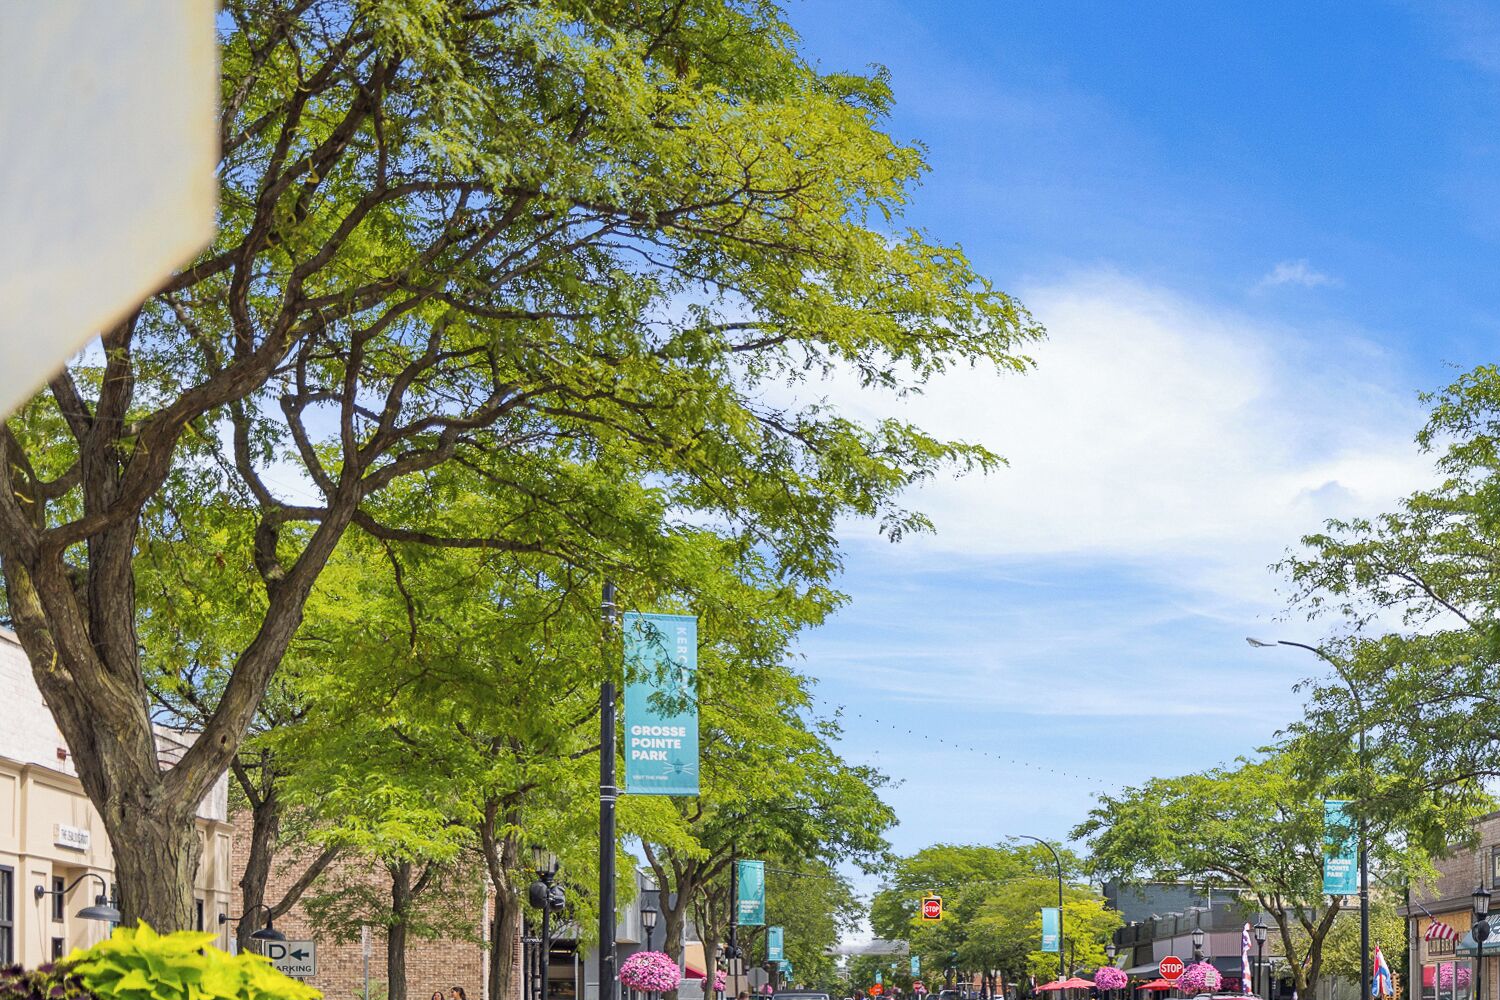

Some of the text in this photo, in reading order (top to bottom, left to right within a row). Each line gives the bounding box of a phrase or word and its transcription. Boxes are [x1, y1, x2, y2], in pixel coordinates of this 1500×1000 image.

[631, 725, 686, 737] GROSSE
[631, 738, 682, 749] POINTE
[631, 750, 668, 761] PARK
[925, 905, 940, 913] STOP
[1161, 963, 1183, 973] STOP
